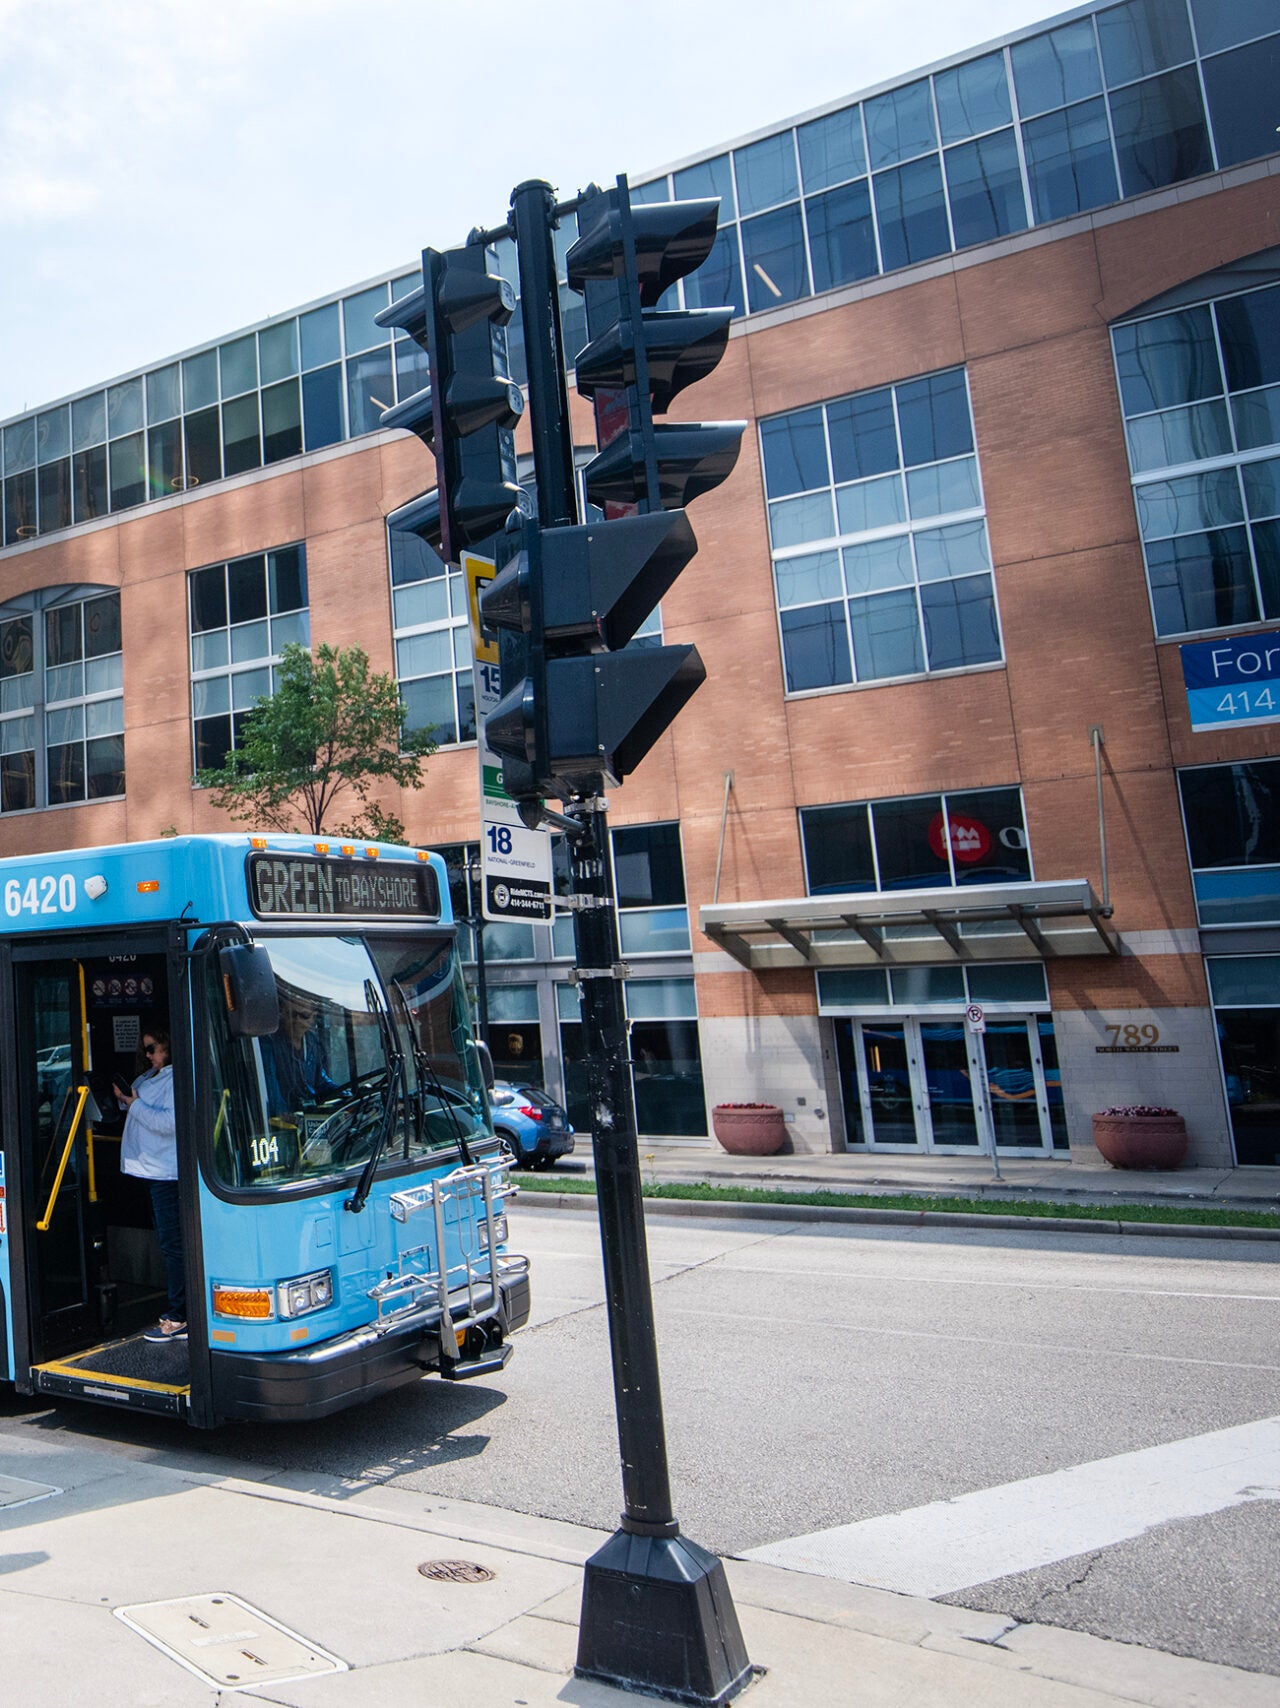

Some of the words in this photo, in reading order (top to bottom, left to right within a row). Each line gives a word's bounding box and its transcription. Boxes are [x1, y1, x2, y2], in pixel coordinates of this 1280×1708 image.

[1211, 647, 1280, 678] For
[480, 665, 500, 695] 15
[1217, 688, 1276, 714] 414
[487, 825, 513, 855] 18
[4, 873, 76, 917] 6420
[255, 860, 335, 913] GREEN
[335, 877, 350, 903] TO
[351, 874, 419, 908] BAYSHORE
[1104, 1024, 1160, 1047] 789
[250, 1135, 279, 1167] 104
